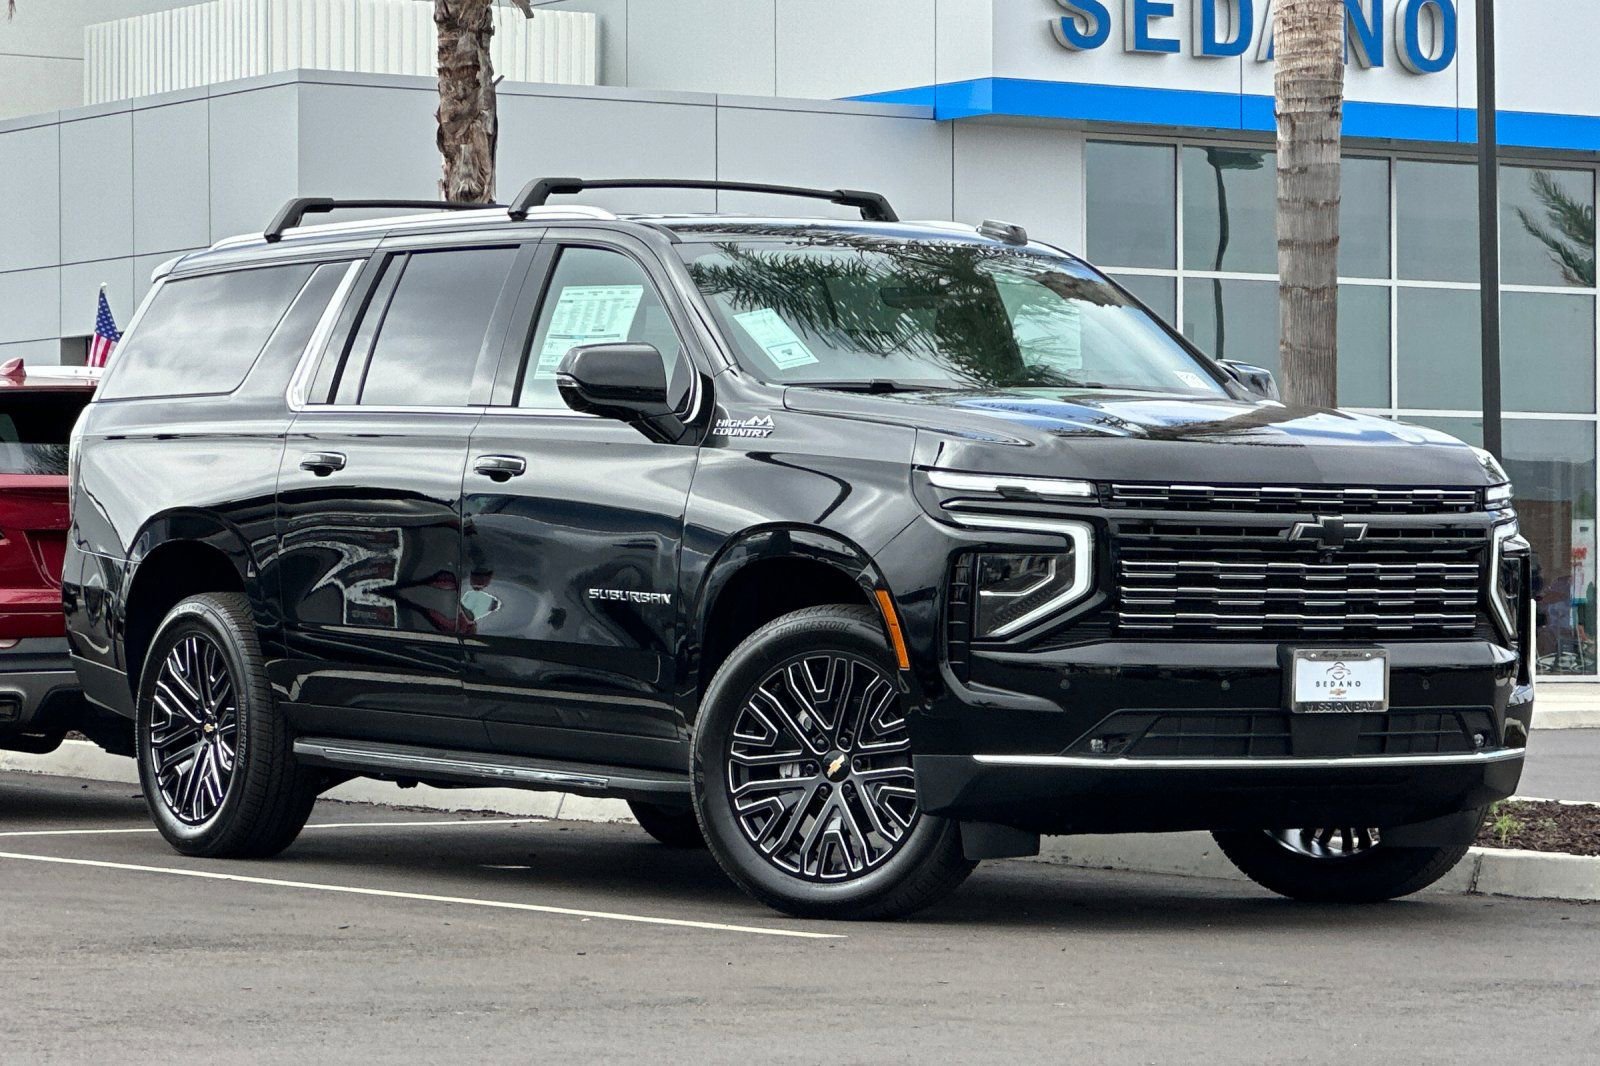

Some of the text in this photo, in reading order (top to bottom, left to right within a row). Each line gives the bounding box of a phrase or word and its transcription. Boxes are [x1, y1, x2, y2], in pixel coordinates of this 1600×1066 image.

[1050, 0, 1457, 75] SEDNO
[716, 419, 746, 428] HIGH
[712, 427, 773, 438] COUNTRY
[588, 588, 671, 604] SUBURBAN
[775, 620, 853, 640] BRIDGESTONE
